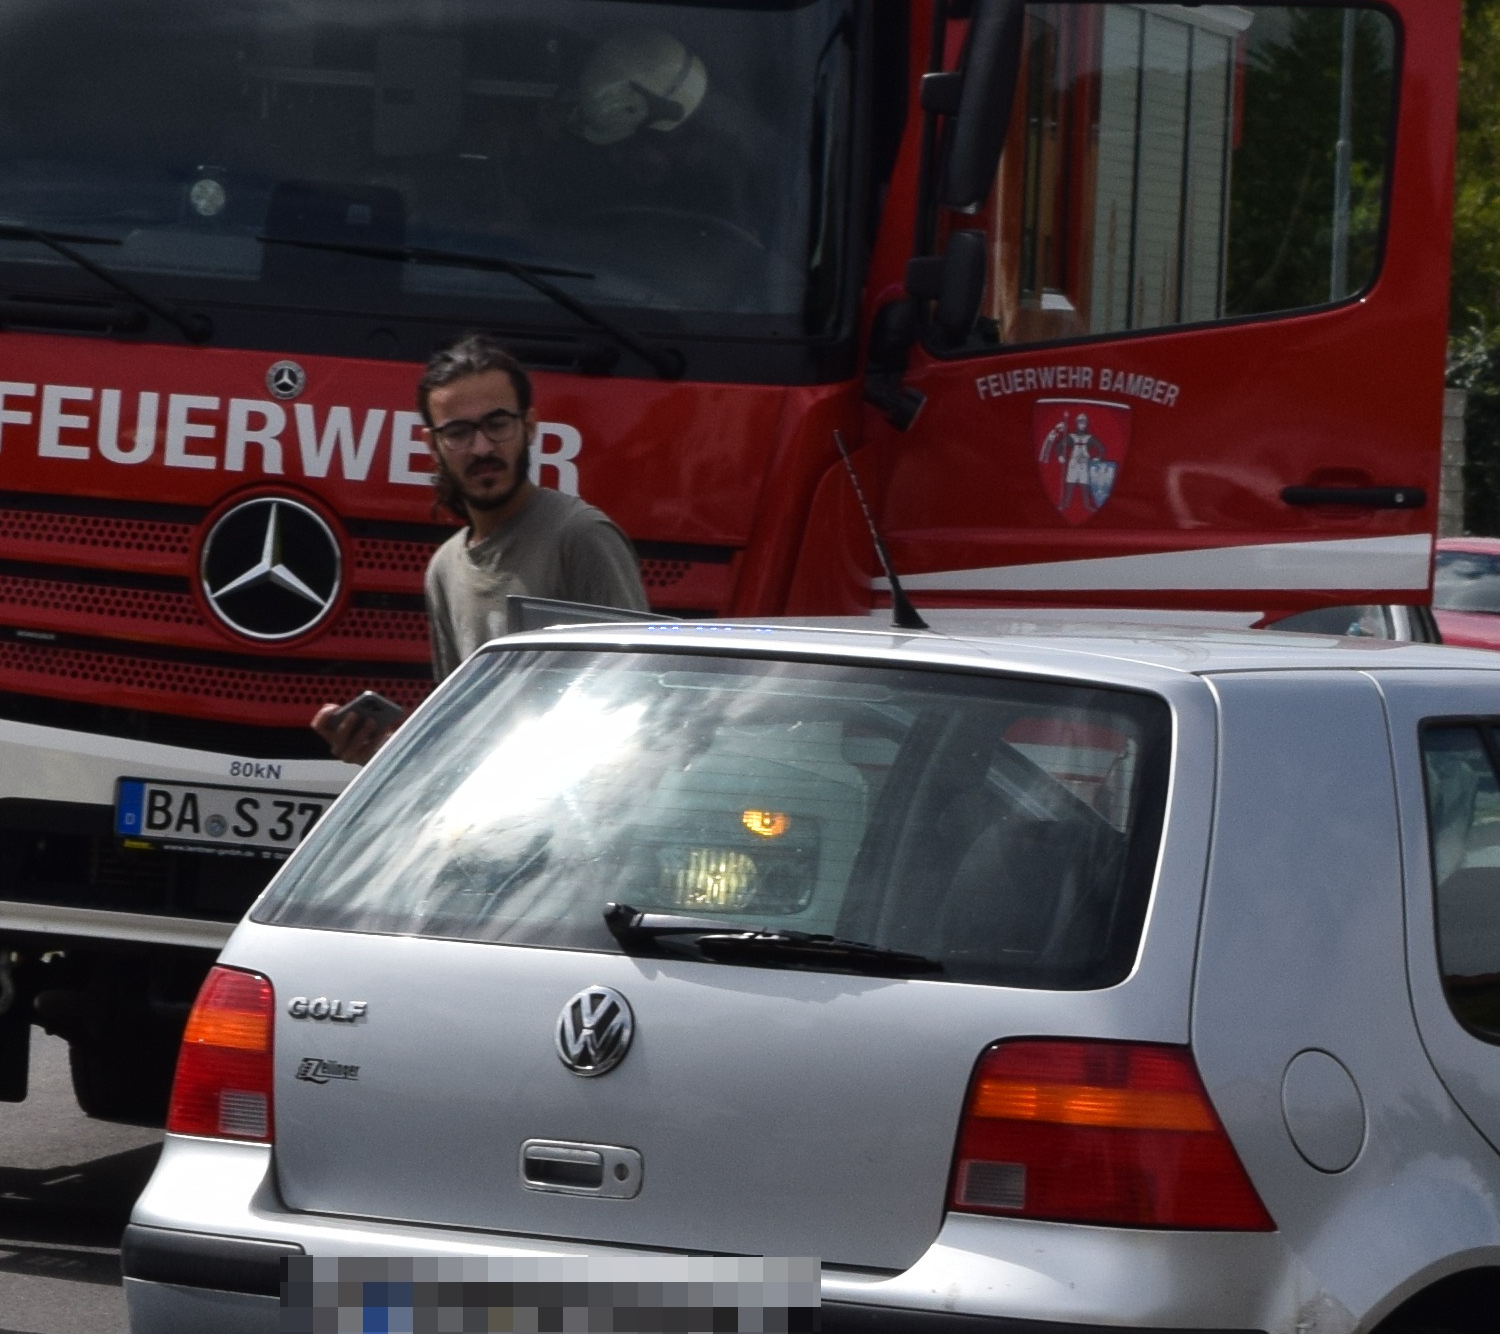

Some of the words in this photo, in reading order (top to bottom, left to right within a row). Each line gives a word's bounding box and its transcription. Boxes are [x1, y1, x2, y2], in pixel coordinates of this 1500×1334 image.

[975, 366, 1094, 400] FEUERWEHR
[1099, 368, 1180, 407] BAMBER
[229, 761, 281, 780] 80kN
[146, 789, 201, 834] BA
[232, 798, 260, 838] S
[286, 996, 368, 1023] GOLF
